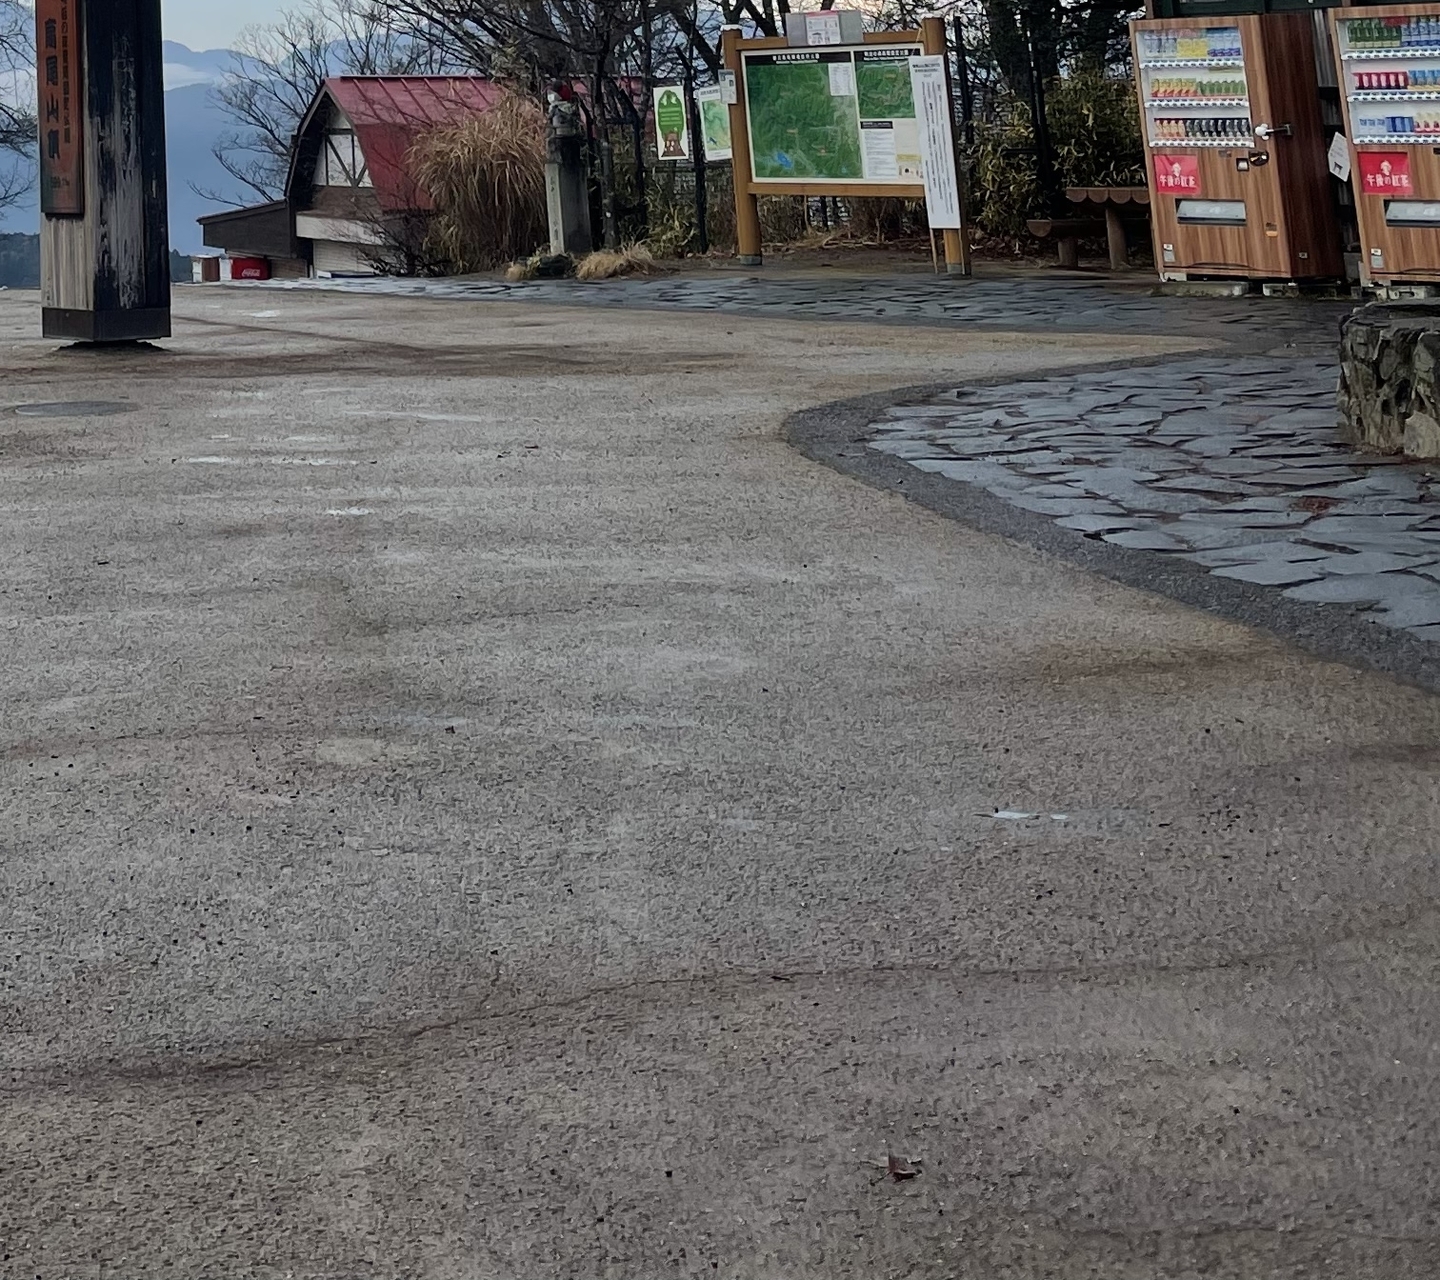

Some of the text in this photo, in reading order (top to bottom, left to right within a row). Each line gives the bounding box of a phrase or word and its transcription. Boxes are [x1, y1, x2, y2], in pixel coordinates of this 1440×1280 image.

[1367, 173, 1410, 187] 午後の紅茶
